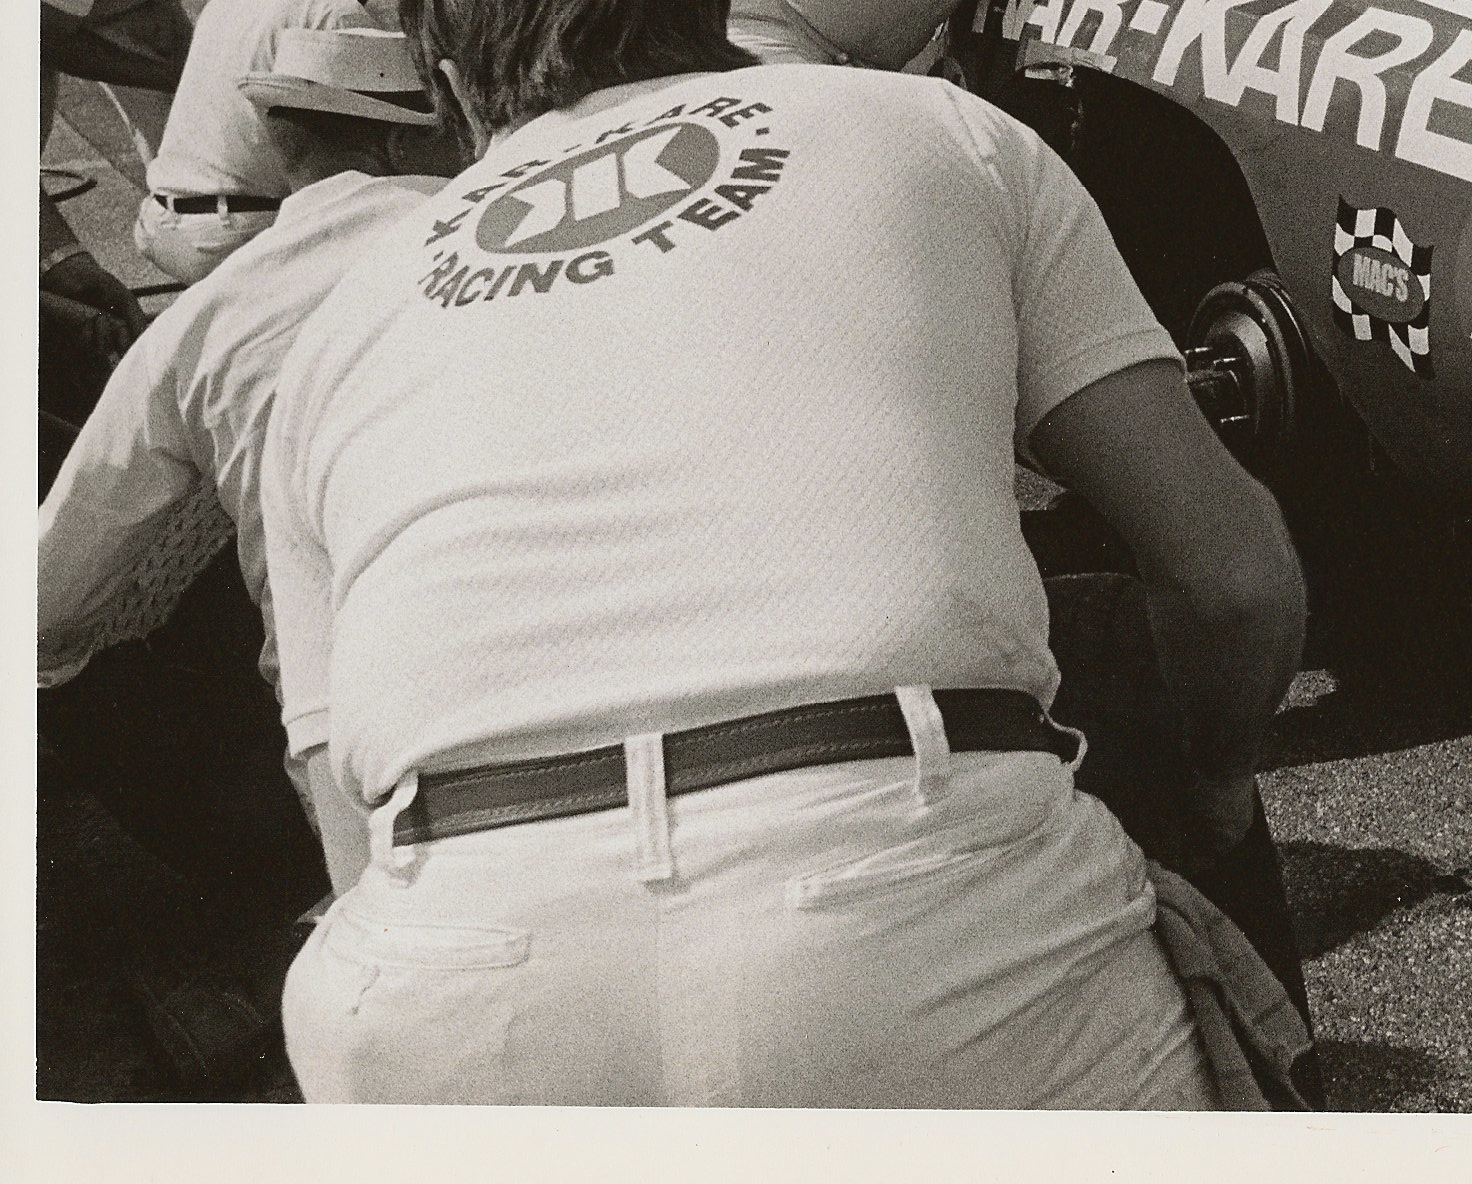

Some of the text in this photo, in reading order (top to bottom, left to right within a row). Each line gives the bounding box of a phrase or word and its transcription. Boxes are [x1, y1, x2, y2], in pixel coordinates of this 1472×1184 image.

[418, 147, 790, 308] RACING TEAM
[1352, 253, 1409, 303] MAC'S
